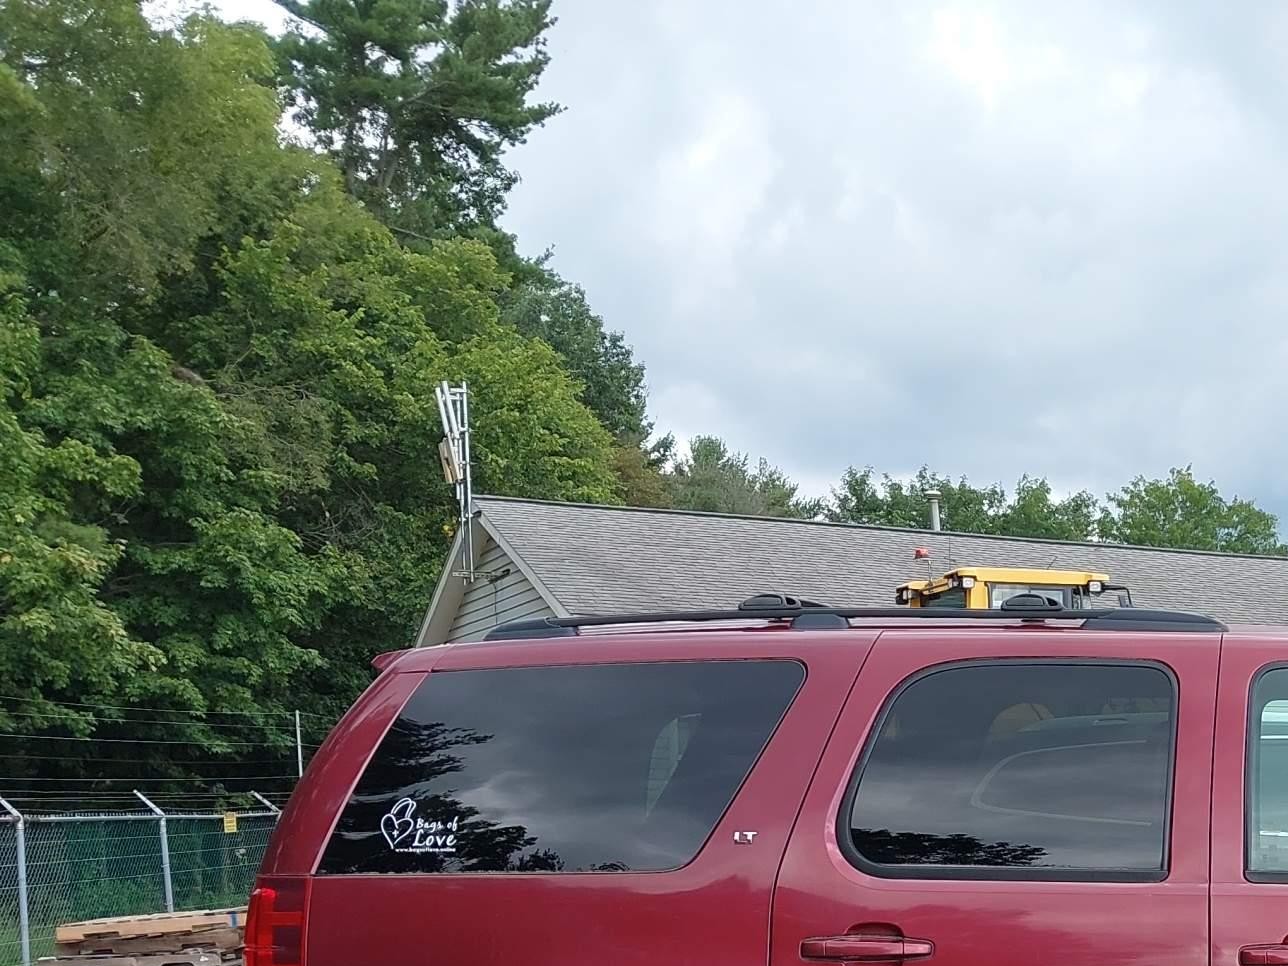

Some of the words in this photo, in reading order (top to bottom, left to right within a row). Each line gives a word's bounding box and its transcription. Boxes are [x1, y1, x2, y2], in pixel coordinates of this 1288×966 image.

[416, 817, 443, 833] Bags
[447, 816, 459, 832] of
[412, 829, 457, 847] Love
[733, 831, 758, 844] LT
